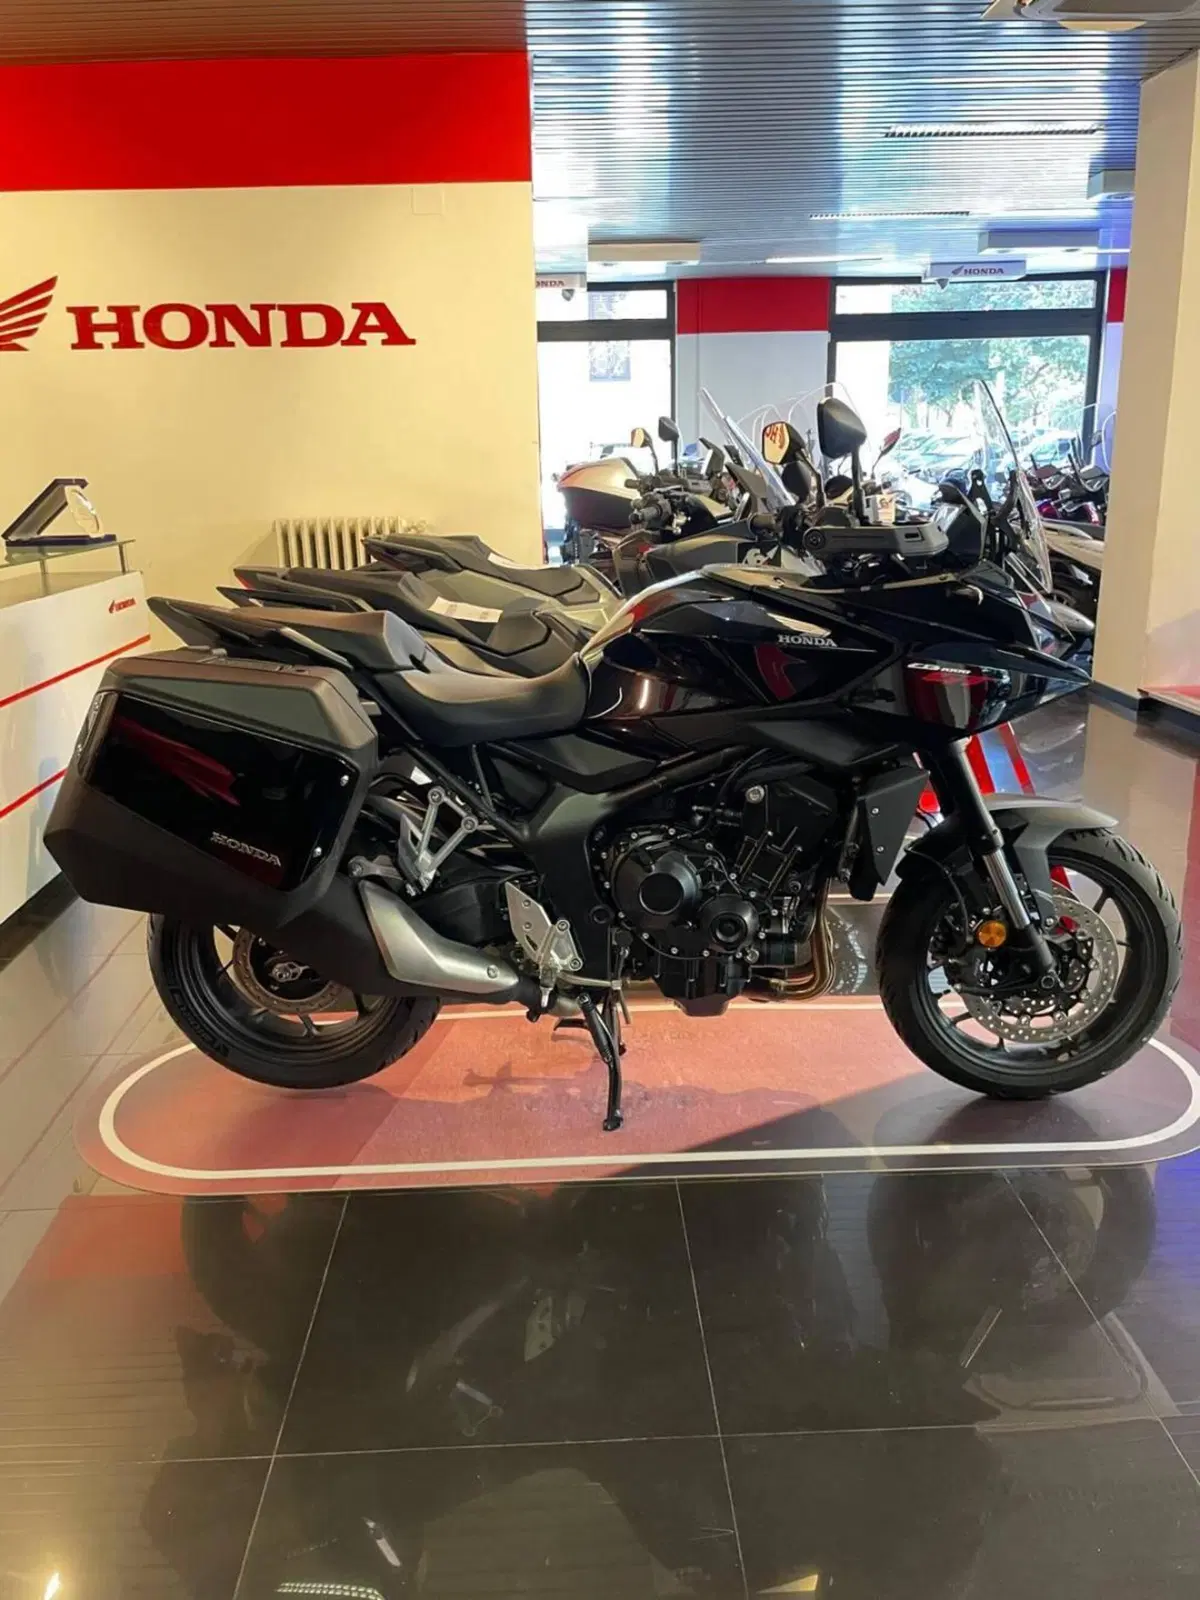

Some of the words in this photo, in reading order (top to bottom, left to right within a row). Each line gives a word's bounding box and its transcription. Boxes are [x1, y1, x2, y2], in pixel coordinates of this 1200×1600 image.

[963, 267, 1005, 276] HONDA
[67, 302, 415, 349] HONDA
[777, 633, 838, 648] HONDA
[210, 831, 282, 867] HONDA
